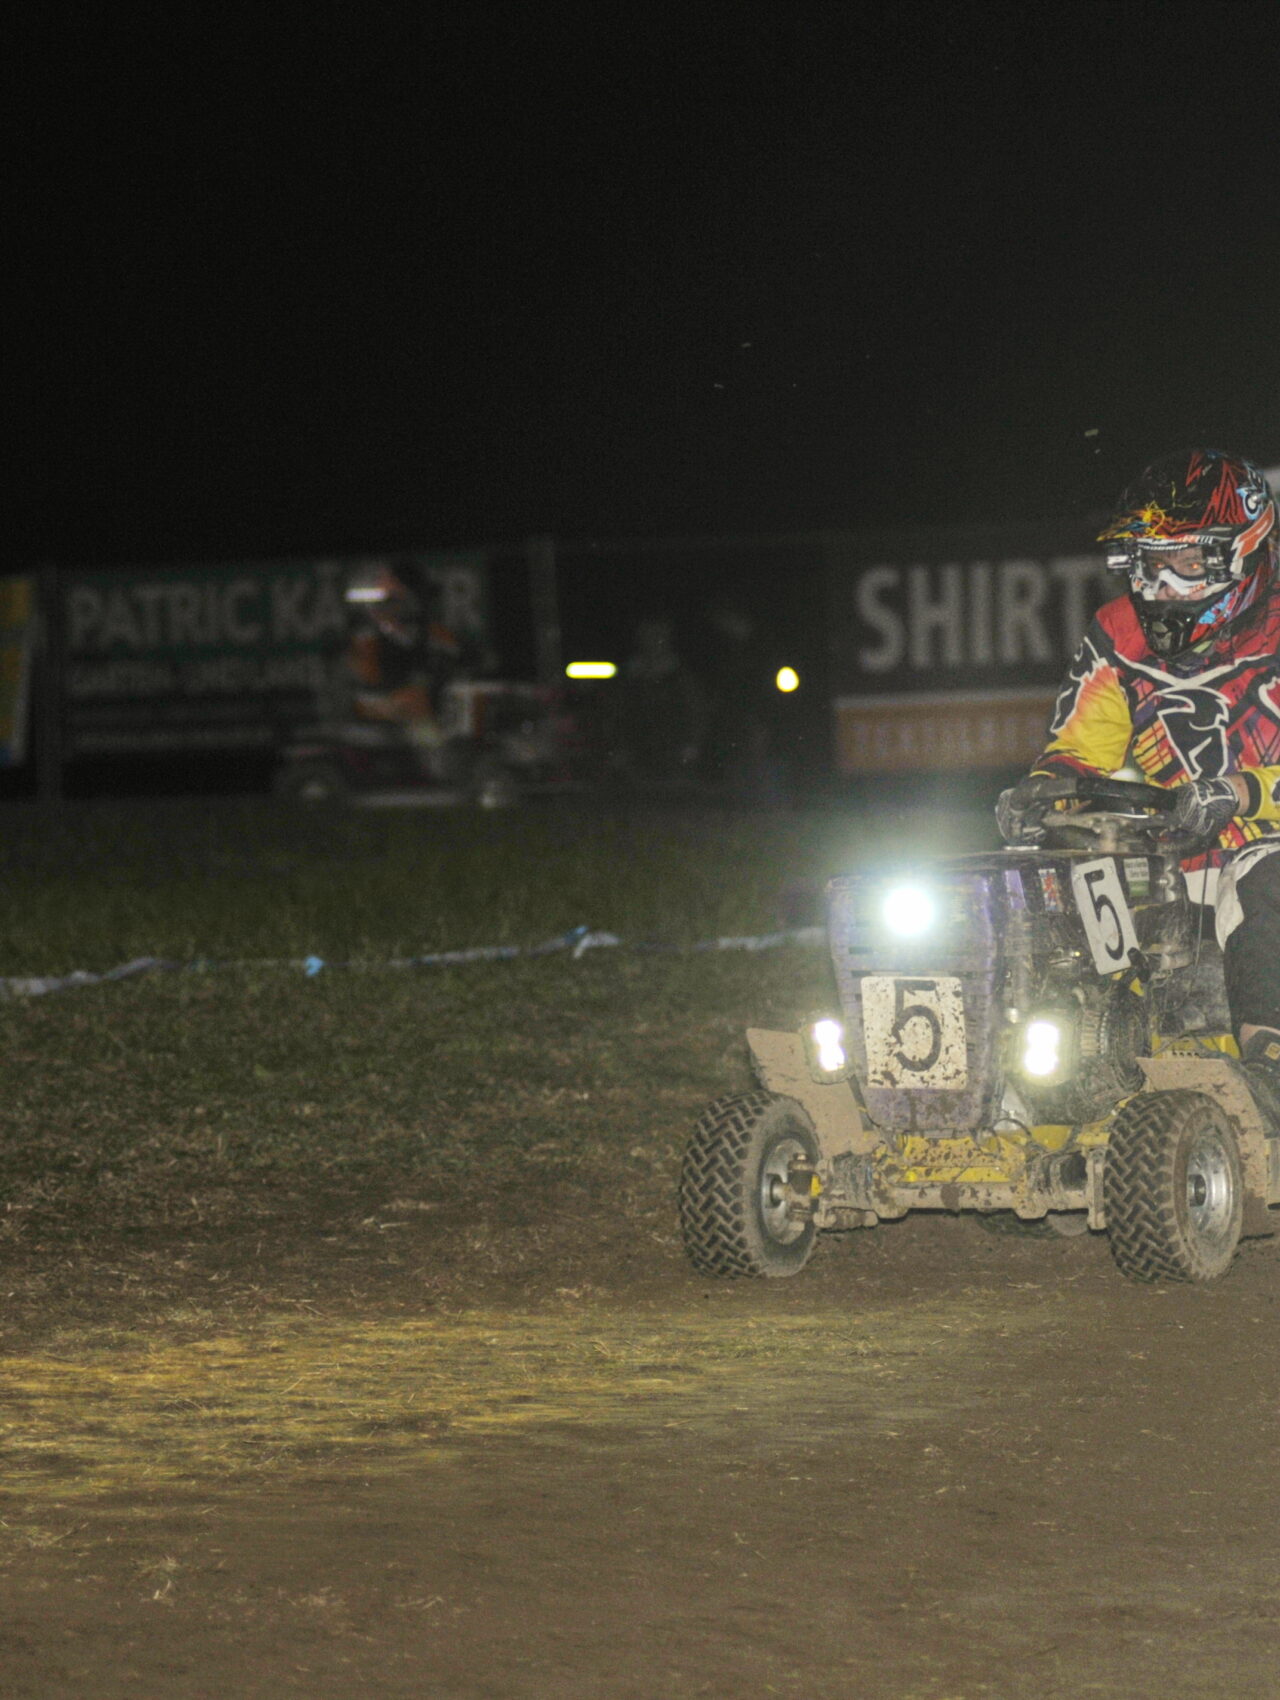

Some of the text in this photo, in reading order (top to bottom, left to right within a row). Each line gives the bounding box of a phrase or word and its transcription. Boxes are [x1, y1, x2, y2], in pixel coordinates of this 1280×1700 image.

[68, 578, 262, 650] PATRIC
[1083, 868, 1125, 961] 5
[893, 979, 941, 1074] 5
